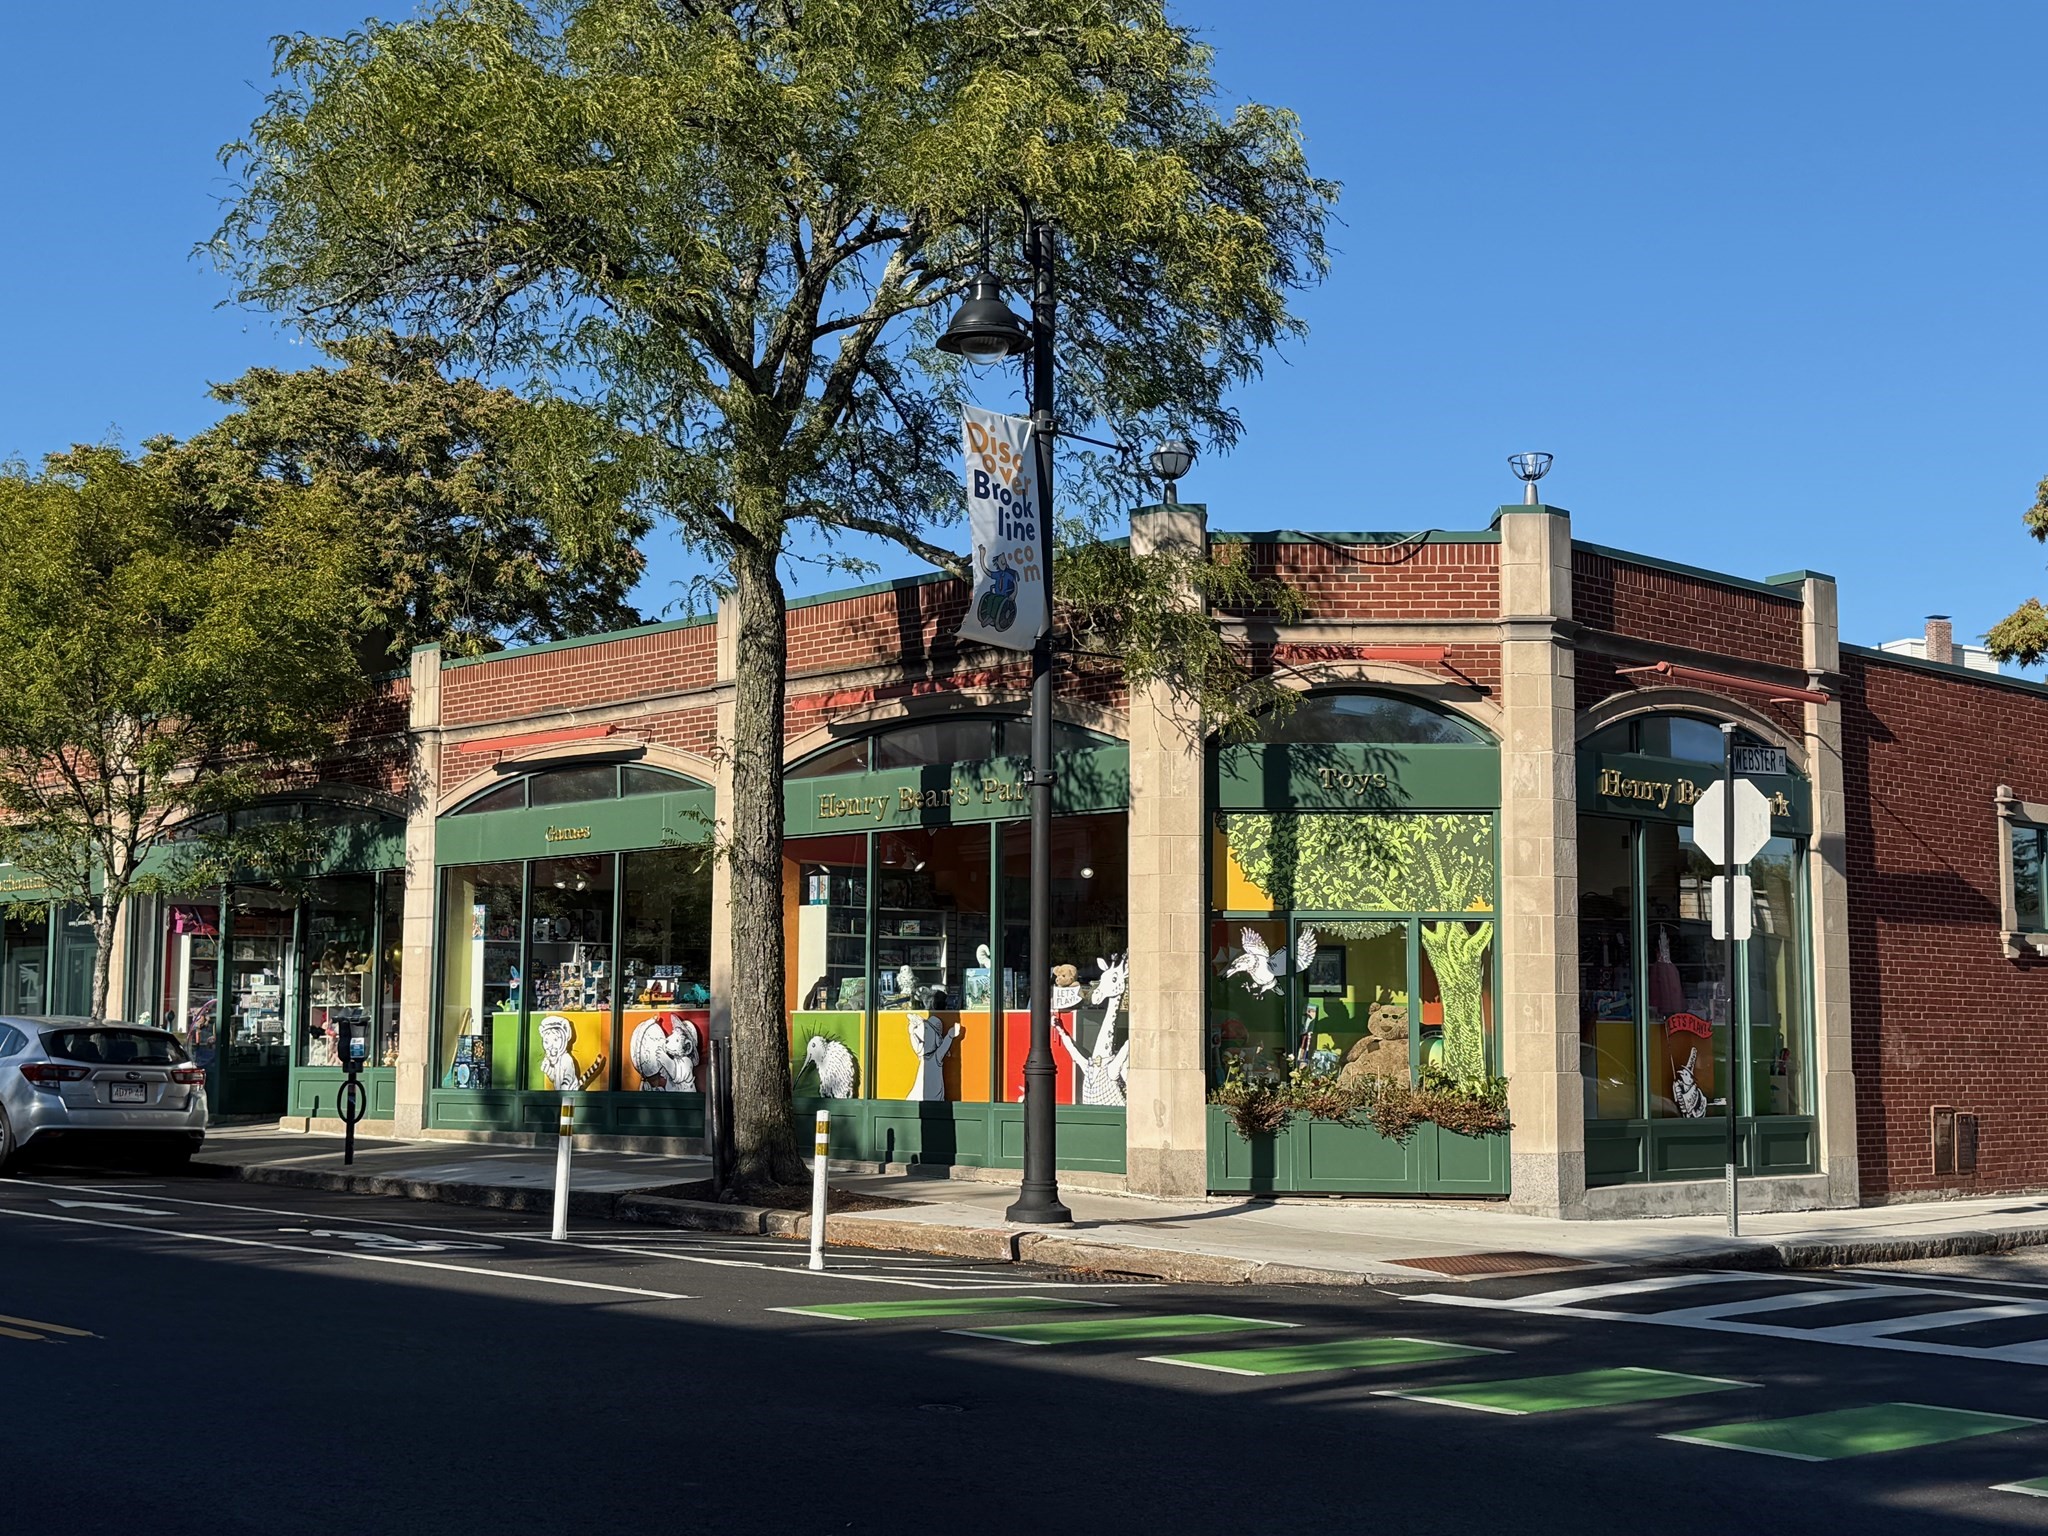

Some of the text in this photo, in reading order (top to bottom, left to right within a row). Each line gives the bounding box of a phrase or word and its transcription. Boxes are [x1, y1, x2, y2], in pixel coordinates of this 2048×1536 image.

[1734, 748, 1785, 772] WEBSTER PL
[1318, 767, 1388, 795] Toys
[1601, 768, 1672, 810] Henry
[1770, 791, 1791, 817] rk
[817, 777, 1032, 821] Henry Bear's Par
[545, 825, 592, 842] Games
